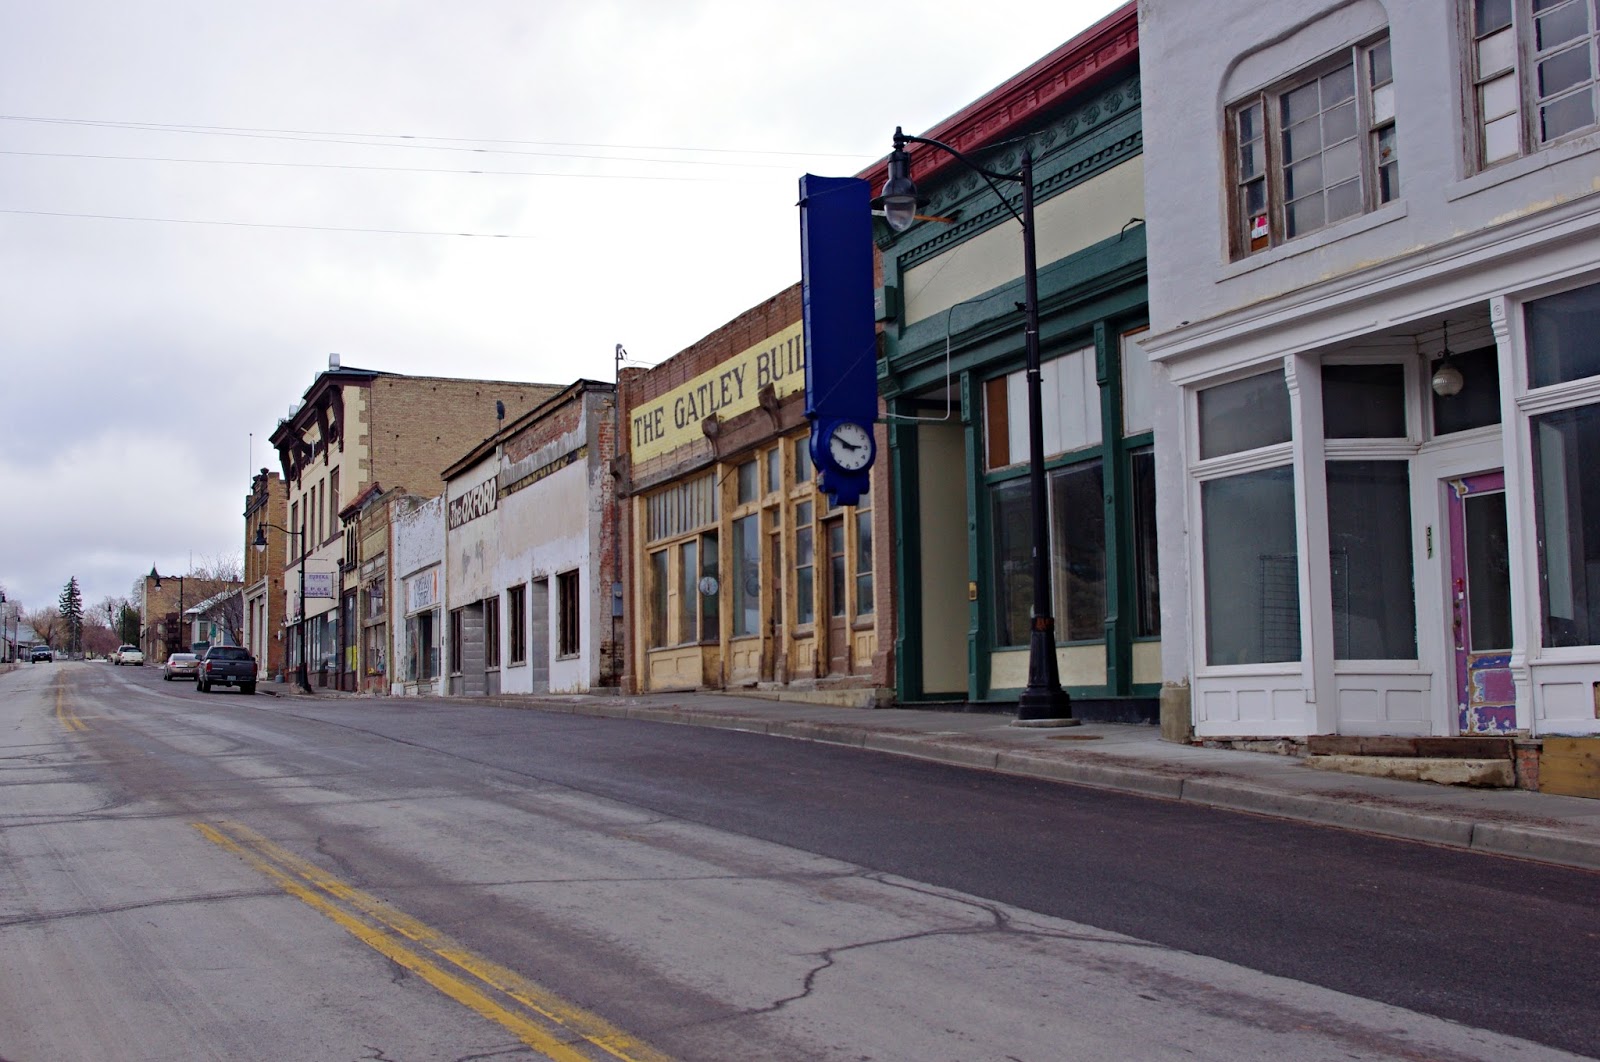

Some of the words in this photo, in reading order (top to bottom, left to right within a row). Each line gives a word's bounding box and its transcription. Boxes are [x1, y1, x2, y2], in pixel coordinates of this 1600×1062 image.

[634, 406, 665, 447] THE
[674, 362, 747, 429] GATLEY
[462, 477, 497, 523] OXFORD
